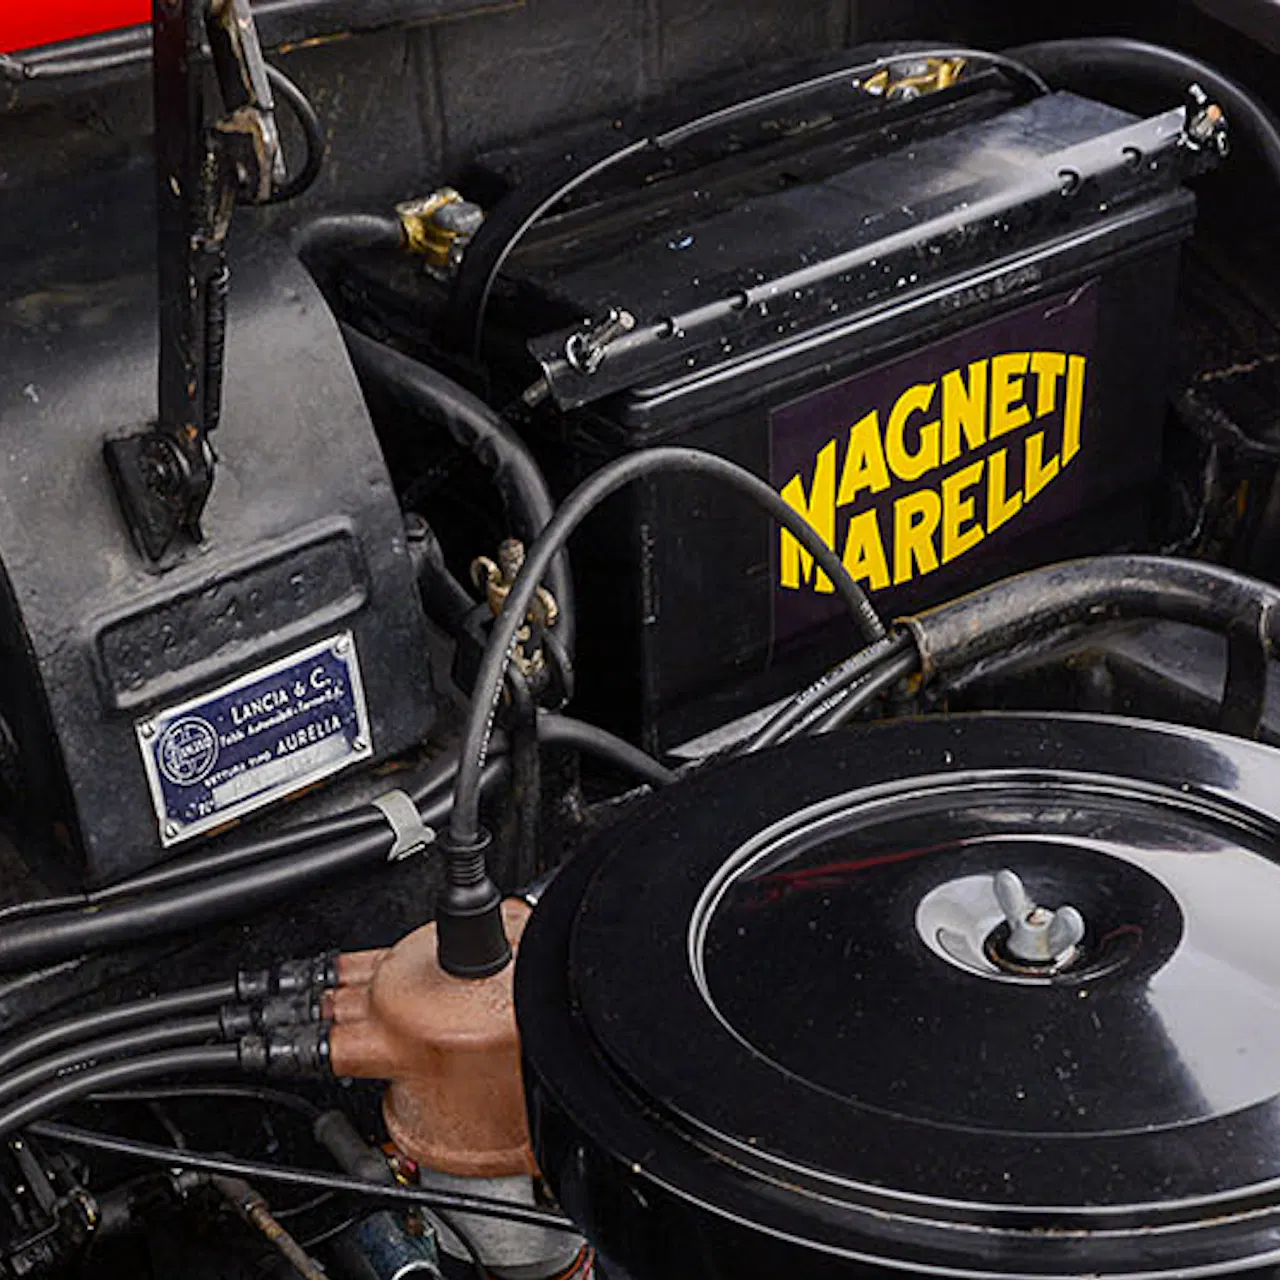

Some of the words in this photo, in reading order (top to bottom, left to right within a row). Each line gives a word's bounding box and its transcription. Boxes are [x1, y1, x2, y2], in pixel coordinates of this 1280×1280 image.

[780, 351, 1087, 560] MAGNETI
[231, 690, 289, 725] LANCIA
[310, 667, 332, 690] C.
[277, 715, 341, 755] AURELIA
